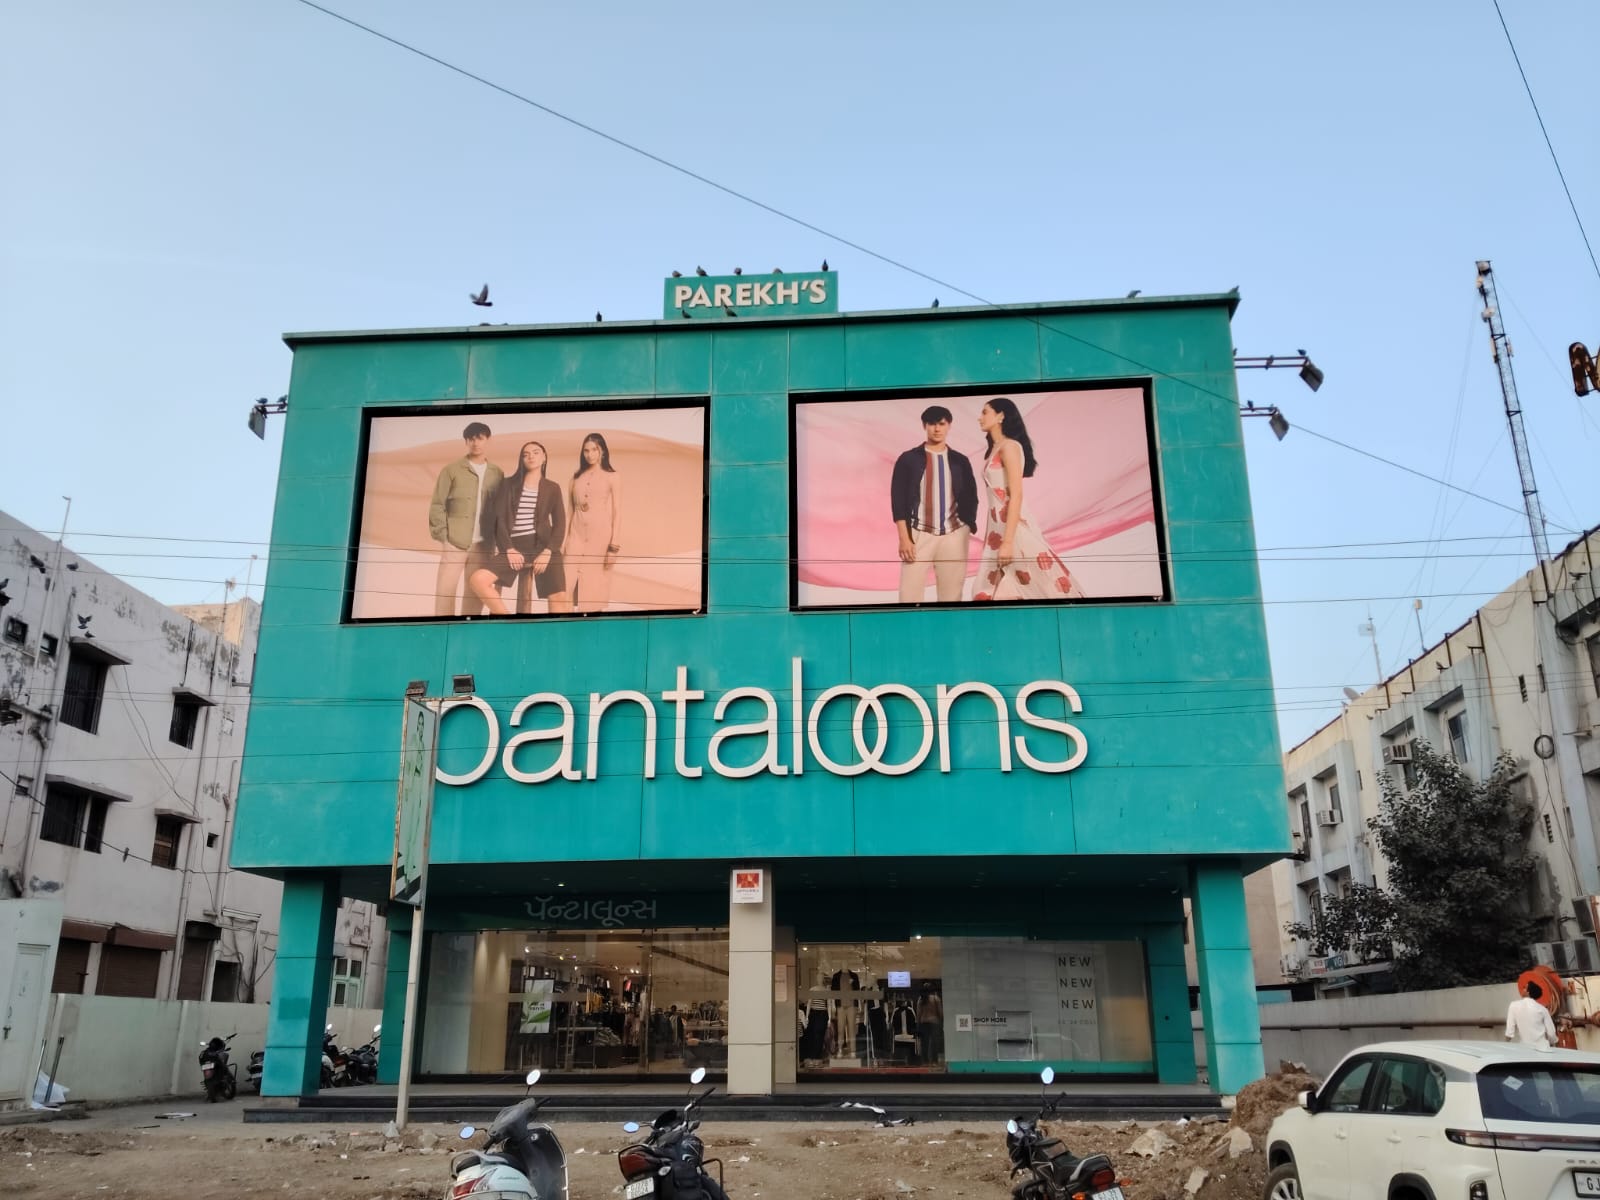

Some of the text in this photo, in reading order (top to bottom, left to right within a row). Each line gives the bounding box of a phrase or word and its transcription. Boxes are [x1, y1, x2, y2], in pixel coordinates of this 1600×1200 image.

[676, 280, 827, 308] PAREKH'S
[1058, 956, 1091, 967] NEW
[1059, 978, 1092, 988] NEW
[1061, 999, 1094, 1009] NEW
